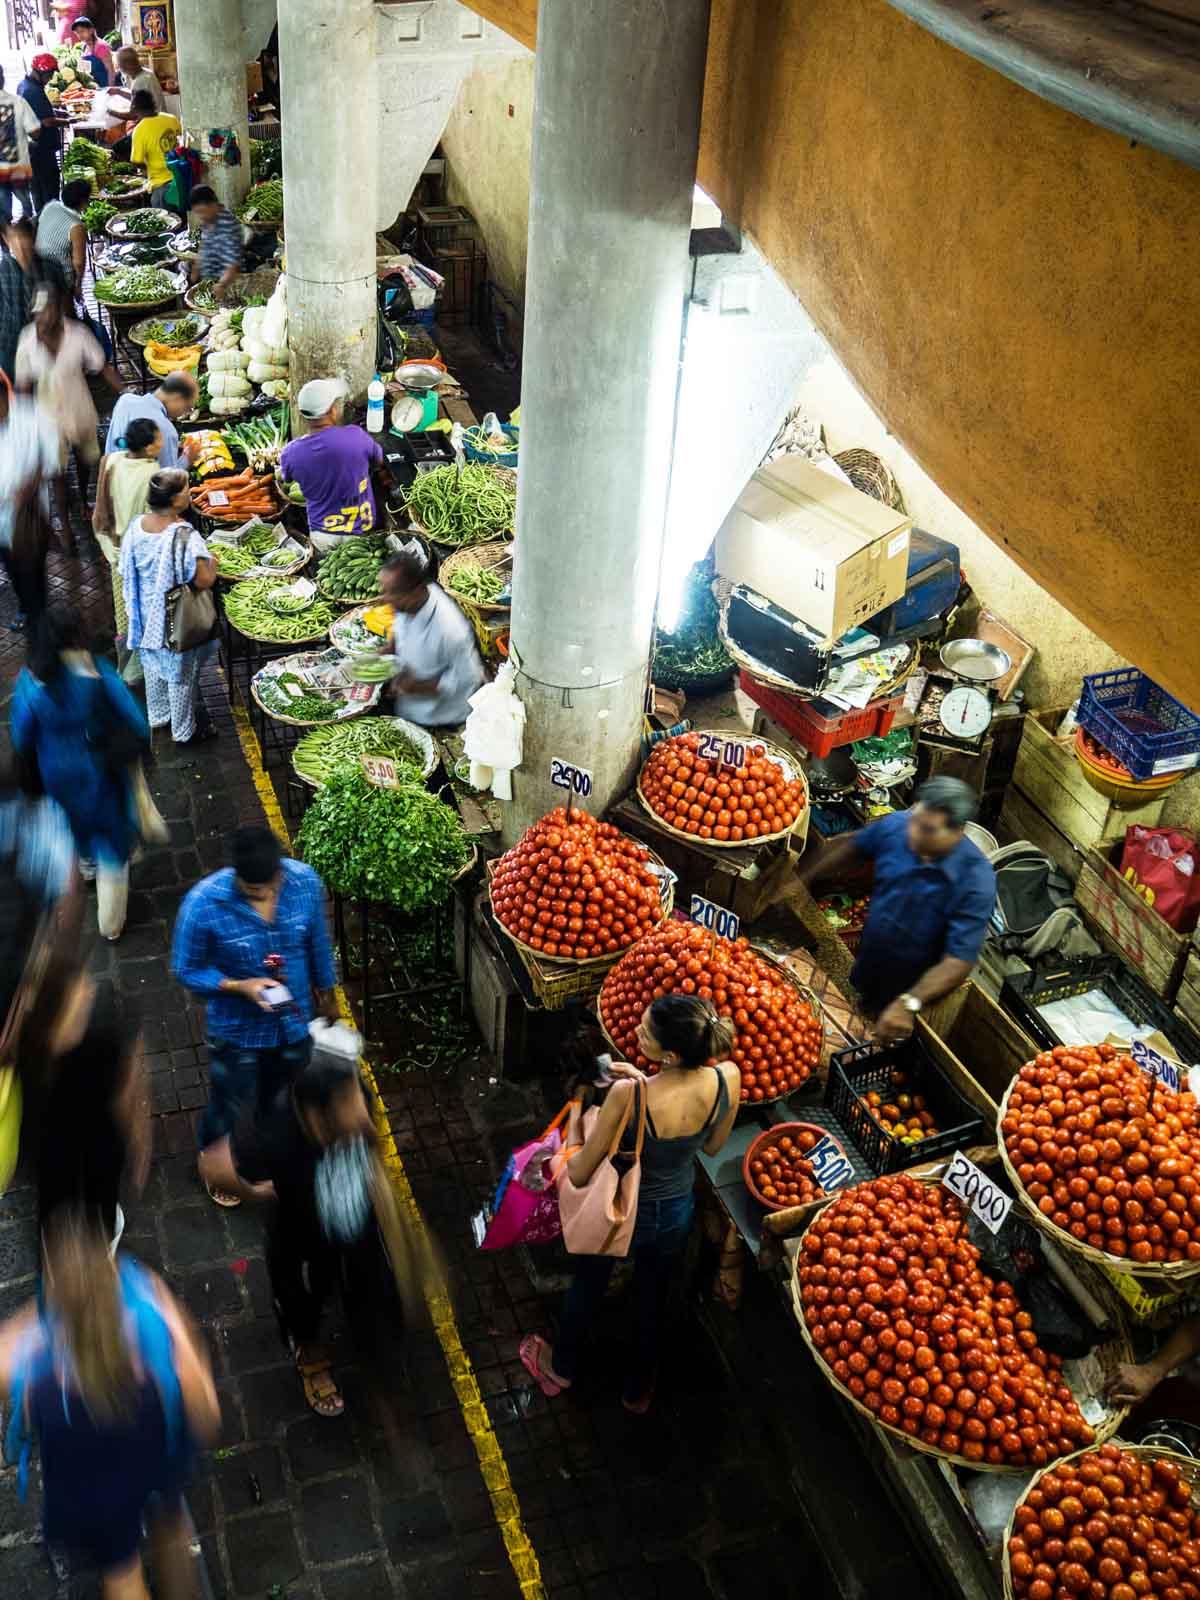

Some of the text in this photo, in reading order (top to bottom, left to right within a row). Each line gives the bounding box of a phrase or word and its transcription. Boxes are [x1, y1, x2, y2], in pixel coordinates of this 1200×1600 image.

[1132, 1041, 1176, 1088] 2500
[805, 1137, 852, 1191] 1500
[948, 1159, 1005, 1221] 2000
